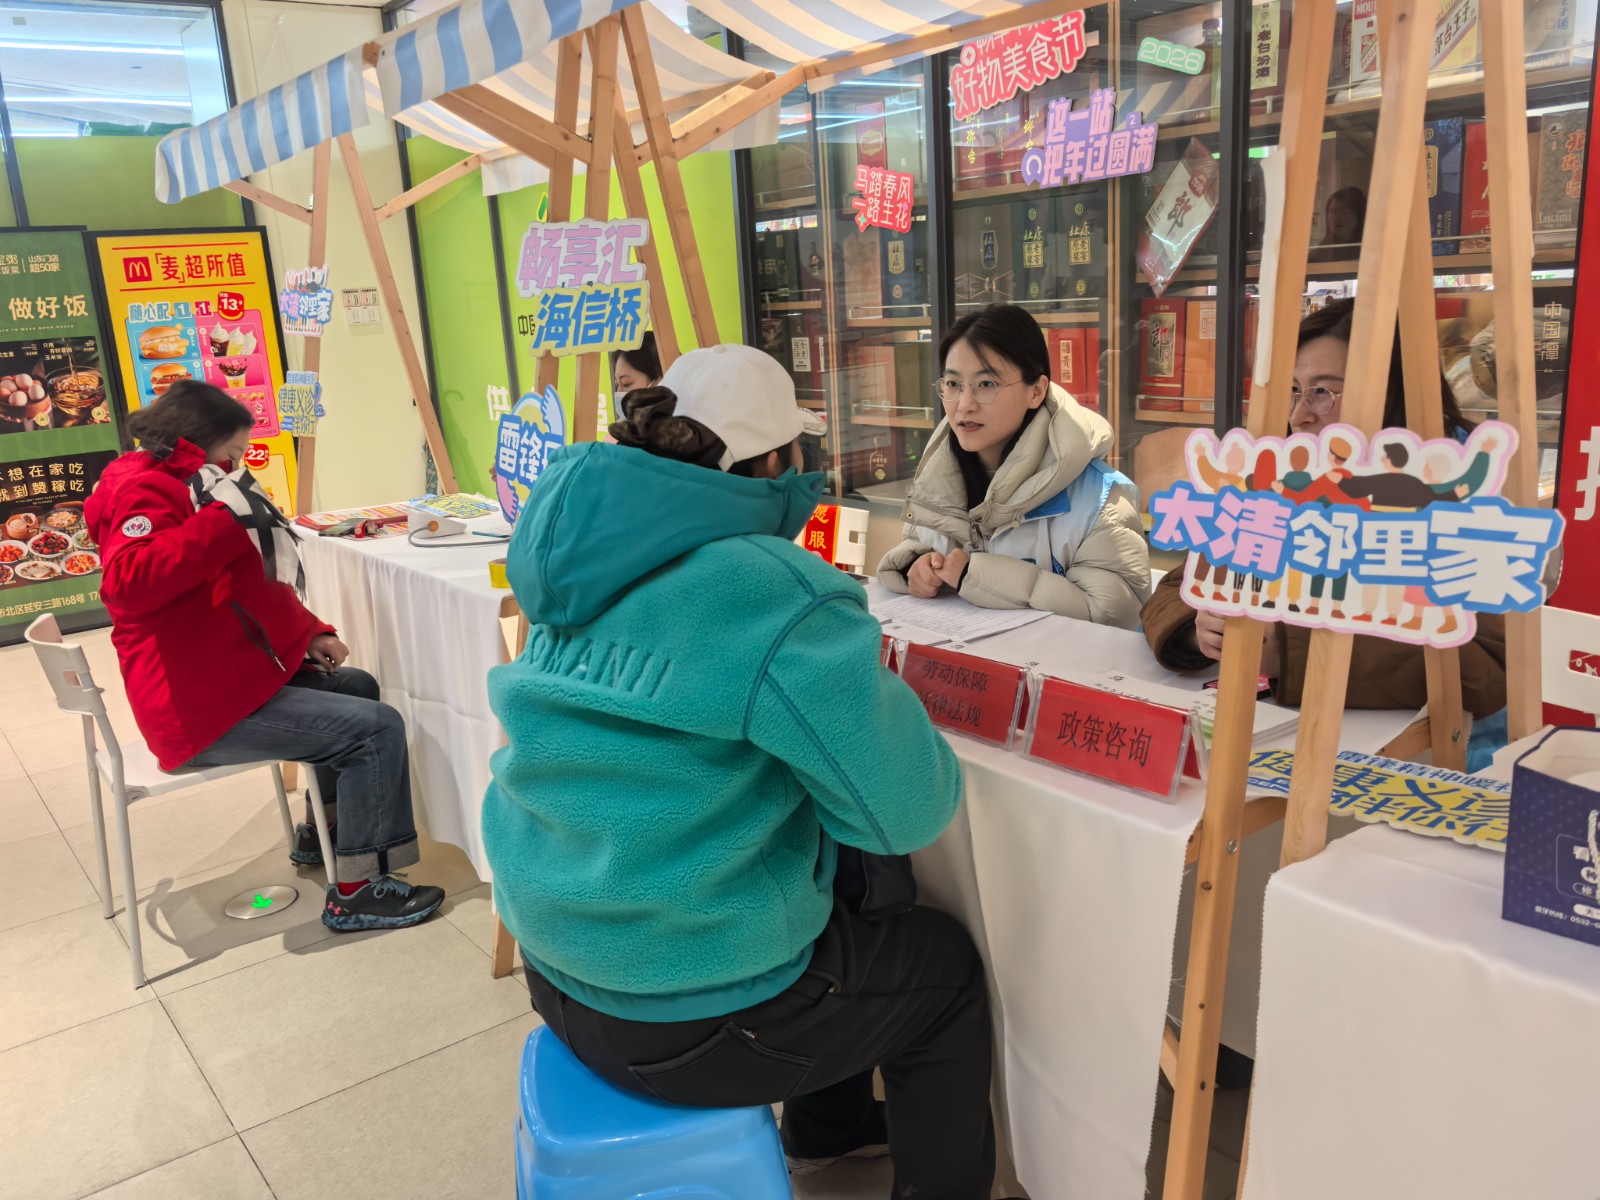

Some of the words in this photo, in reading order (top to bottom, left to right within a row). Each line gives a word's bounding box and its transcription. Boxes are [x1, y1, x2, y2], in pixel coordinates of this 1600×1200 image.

[954, 16, 1080, 113] 好物美食节
[1140, 41, 1202, 71] 2026
[1047, 88, 1115, 143] 这一站
[1042, 125, 1155, 186] 把年过圆满
[856, 168, 911, 203] 马踏春风
[854, 197, 908, 229] 一路生花
[29, 262, 60, 273] 超50家
[518, 225, 641, 290] 畅享汇
[8, 295, 89, 321] 做好饭
[129, 302, 171, 322] 随心配
[280, 289, 331, 323] 太清邻里家
[532, 287, 642, 349] 海信桥
[278, 387, 316, 414] 健康义诊
[1153, 488, 1553, 605] 太清邻里家
[922, 660, 989, 694] 劳动保障
[1056, 710, 1152, 768] 政策咨询
